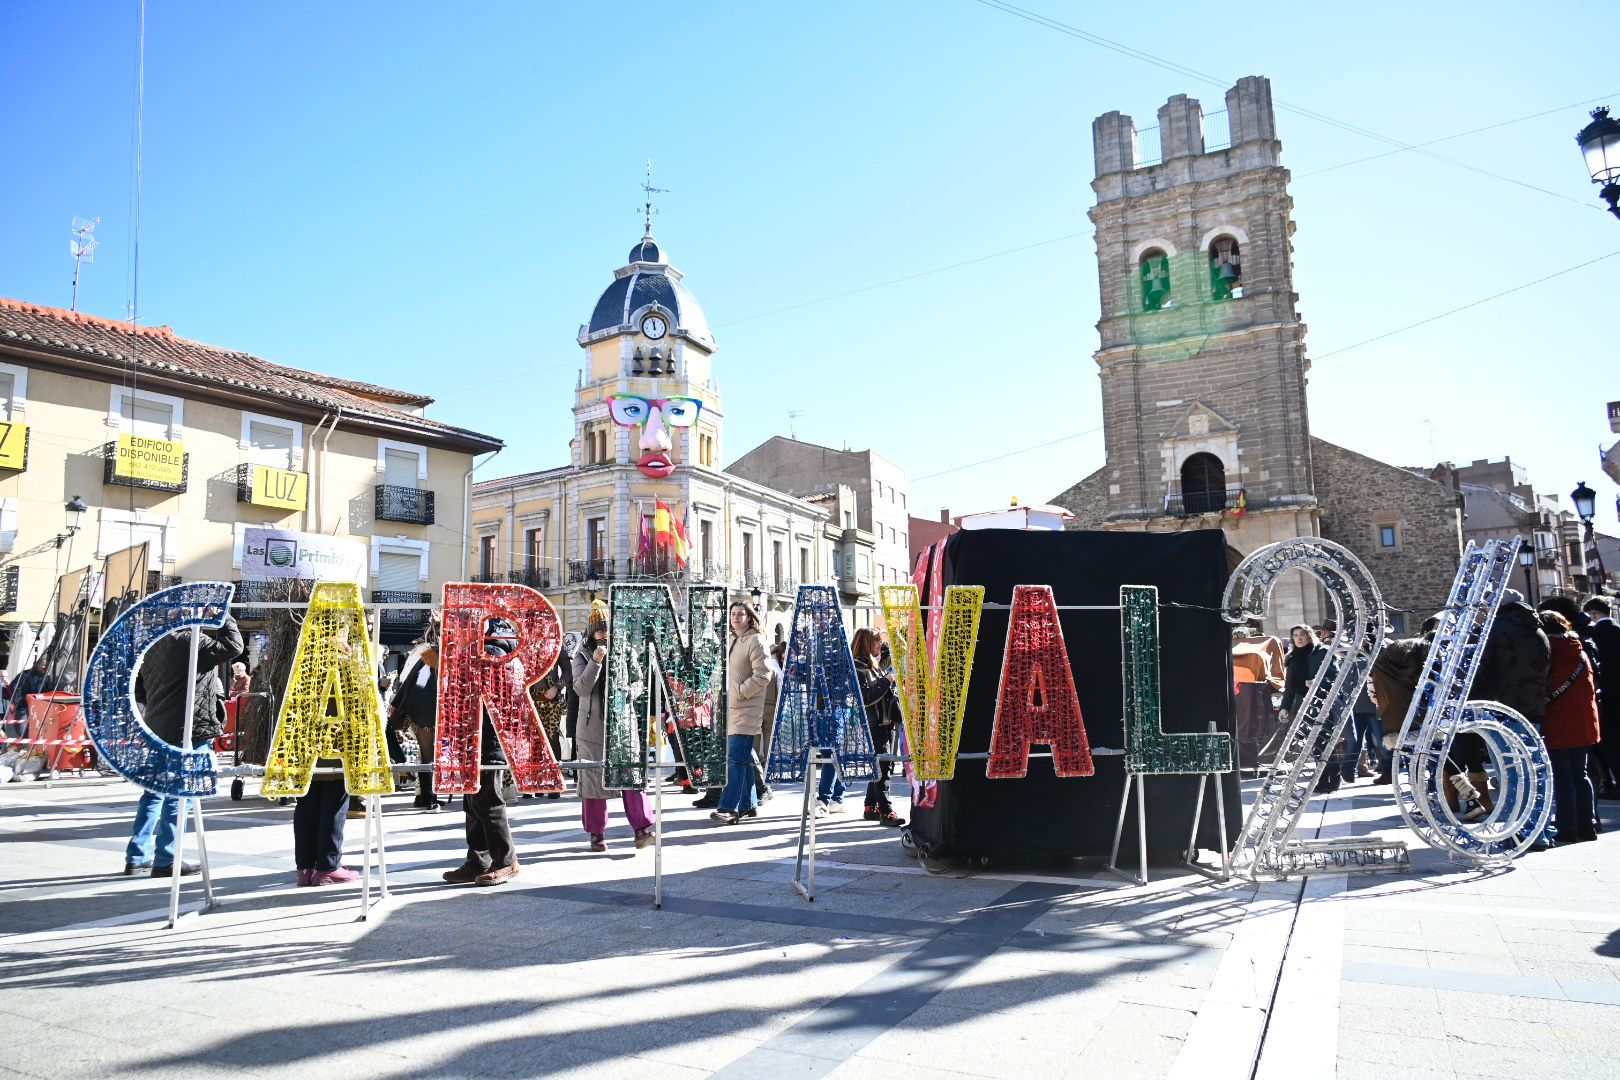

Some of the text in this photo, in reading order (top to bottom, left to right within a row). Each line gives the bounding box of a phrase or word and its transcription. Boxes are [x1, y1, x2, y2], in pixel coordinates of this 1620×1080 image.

[130, 436, 173, 453] EDIFICIO
[120, 447, 180, 466] DISPONIBLE
[264, 469, 298, 502] LUZ
[246, 545, 265, 556] Las
[83, 579, 1234, 800] CARNAVAL
[1221, 534, 1555, 882] 26
